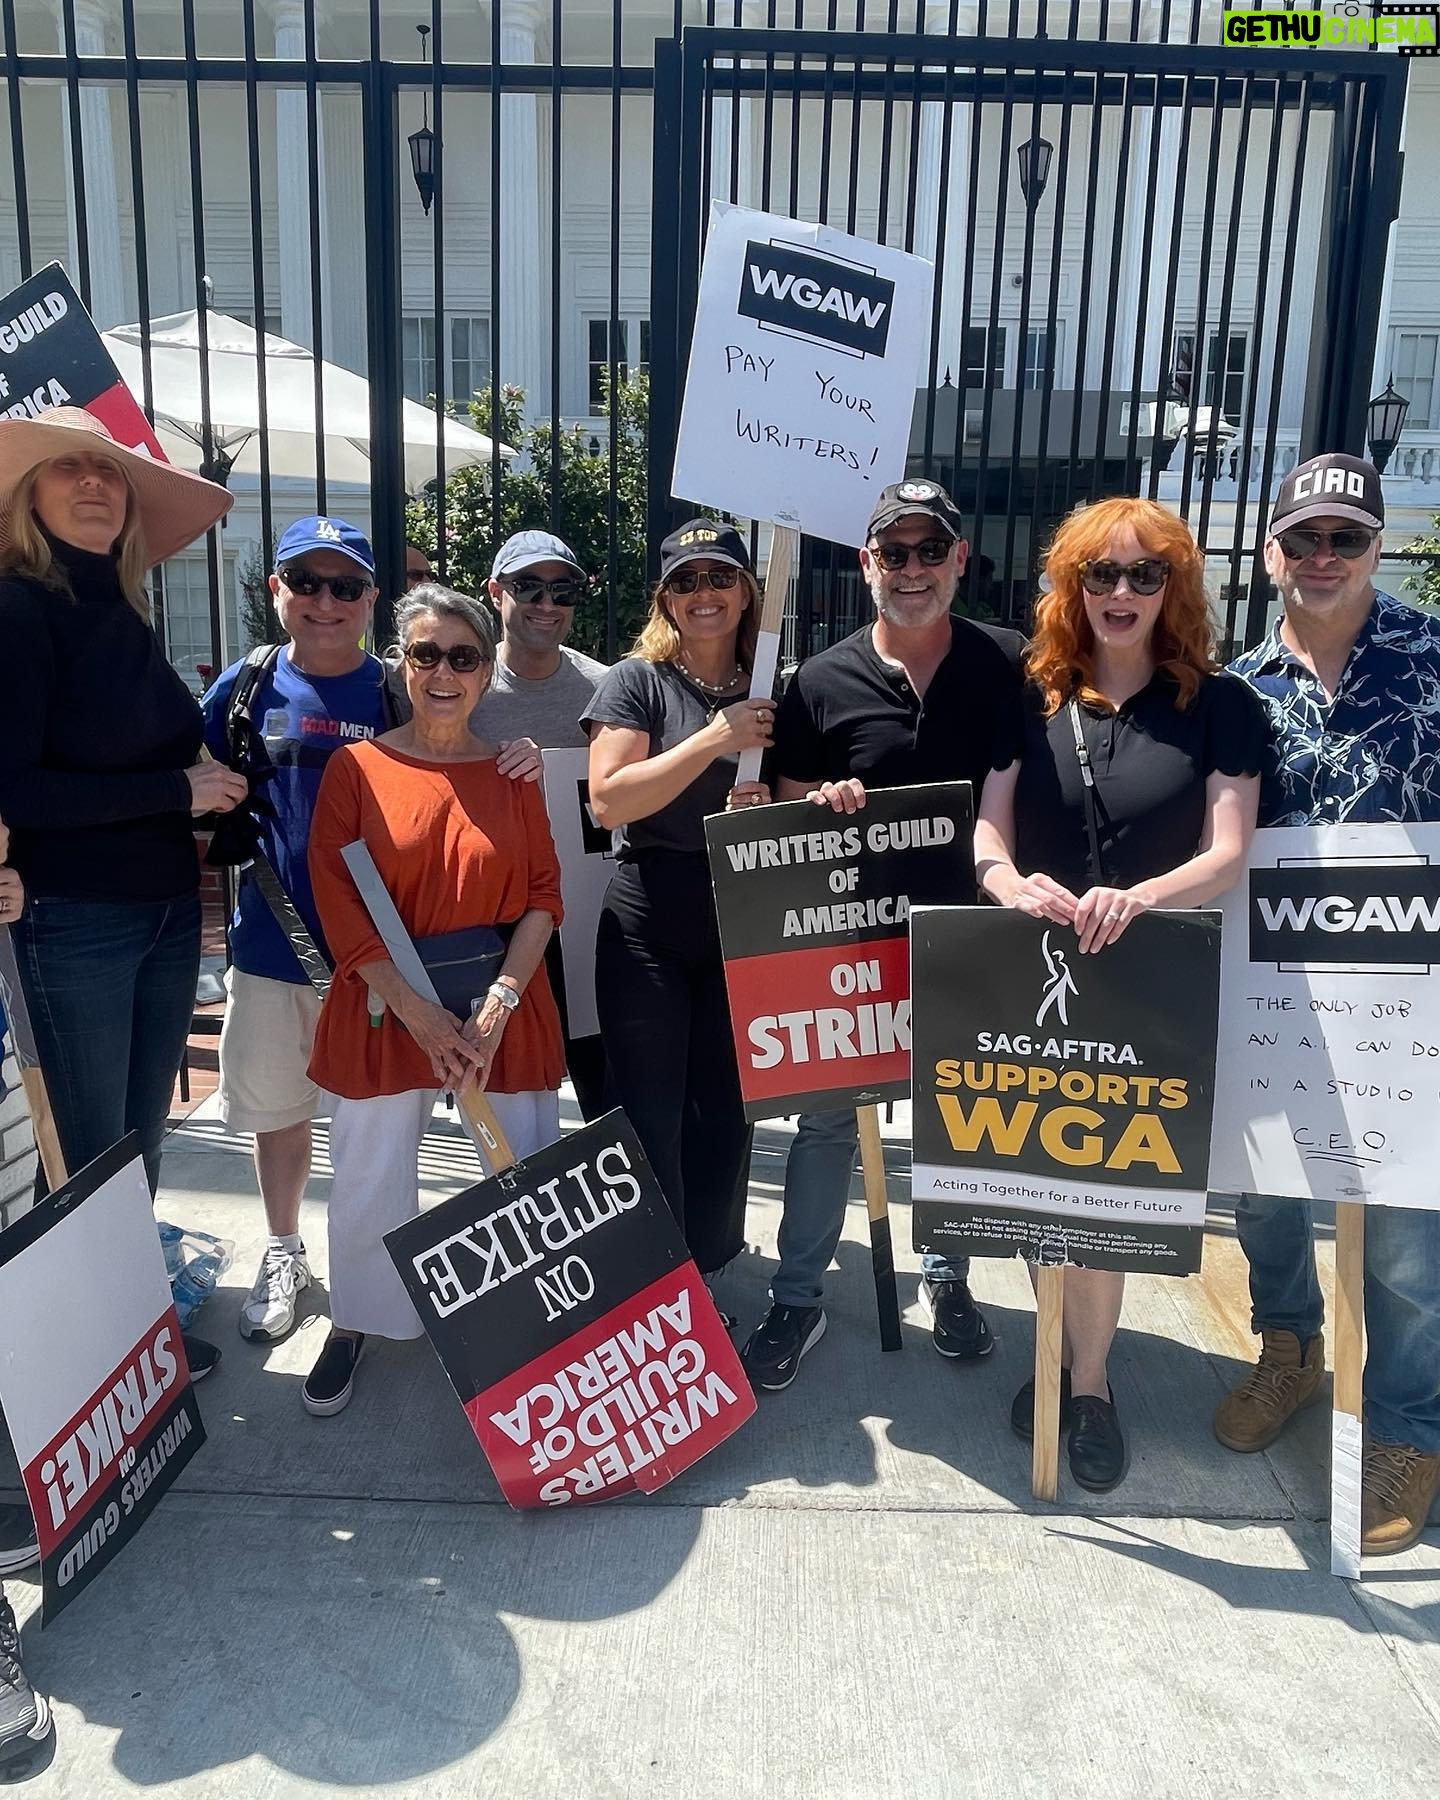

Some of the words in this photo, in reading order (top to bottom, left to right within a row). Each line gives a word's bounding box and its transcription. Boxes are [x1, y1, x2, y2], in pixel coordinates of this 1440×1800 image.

[0, 291, 68, 354] GUILD
[749, 263, 887, 329] WGAW
[724, 345, 775, 382] PAY
[815, 370, 876, 424] YOUR
[736, 408, 879, 480] WRITERS!
[725, 827, 862, 873] WRITERS
[866, 816, 955, 853] GUILD
[828, 867, 859, 894] OF
[782, 895, 910, 938] AMERICA
[1256, 895, 1440, 933] WGAW
[829, 959, 882, 997] ON
[1246, 996, 1297, 1011] THE
[1308, 999, 1359, 1016] ONLY
[1370, 999, 1412, 1019] JOB
[1248, 1031, 1280, 1046] AN
[1355, 1040, 1392, 1053] CAN
[1411, 1040, 1440, 1057] DO
[935, 1059, 1189, 1110] SUPPORTS
[1249, 1077, 1270, 1090] IN
[1292, 1079, 1308, 1092] A
[1326, 1079, 1413, 1101] STUDIO
[935, 1093, 1184, 1175] WGA
[932, 1178, 978, 1194] Acting
[982, 1182, 1044, 1199] Together
[1048, 1190, 1068, 1202] for
[1071, 1195, 1080, 1205] a
[1084, 1195, 1130, 1210] Better
[1133, 1200, 1183, 1213] Future
[412, 1141, 643, 1319] STRIKE
[1011, 1219, 1027, 1227] with
[1107, 1232, 1121, 1240] this
[1012, 1234, 1028, 1242] pick
[1103, 1246, 1138, 1255] transport
[1111, 1240, 1153, 1250] performing
[533, 1254, 596, 1323] ON
[488, 1287, 694, 1447] AMERICA
[576, 1338, 707, 1448] GUILD
[40, 1326, 178, 1532] STRIKE!
[528, 1425, 576, 1476] OF
[539, 1370, 738, 1507] WRITERS
[118, 1445, 136, 1478] ON
[120, 1407, 193, 1518] WRITERS
[56, 1492, 121, 1588] GUILD
